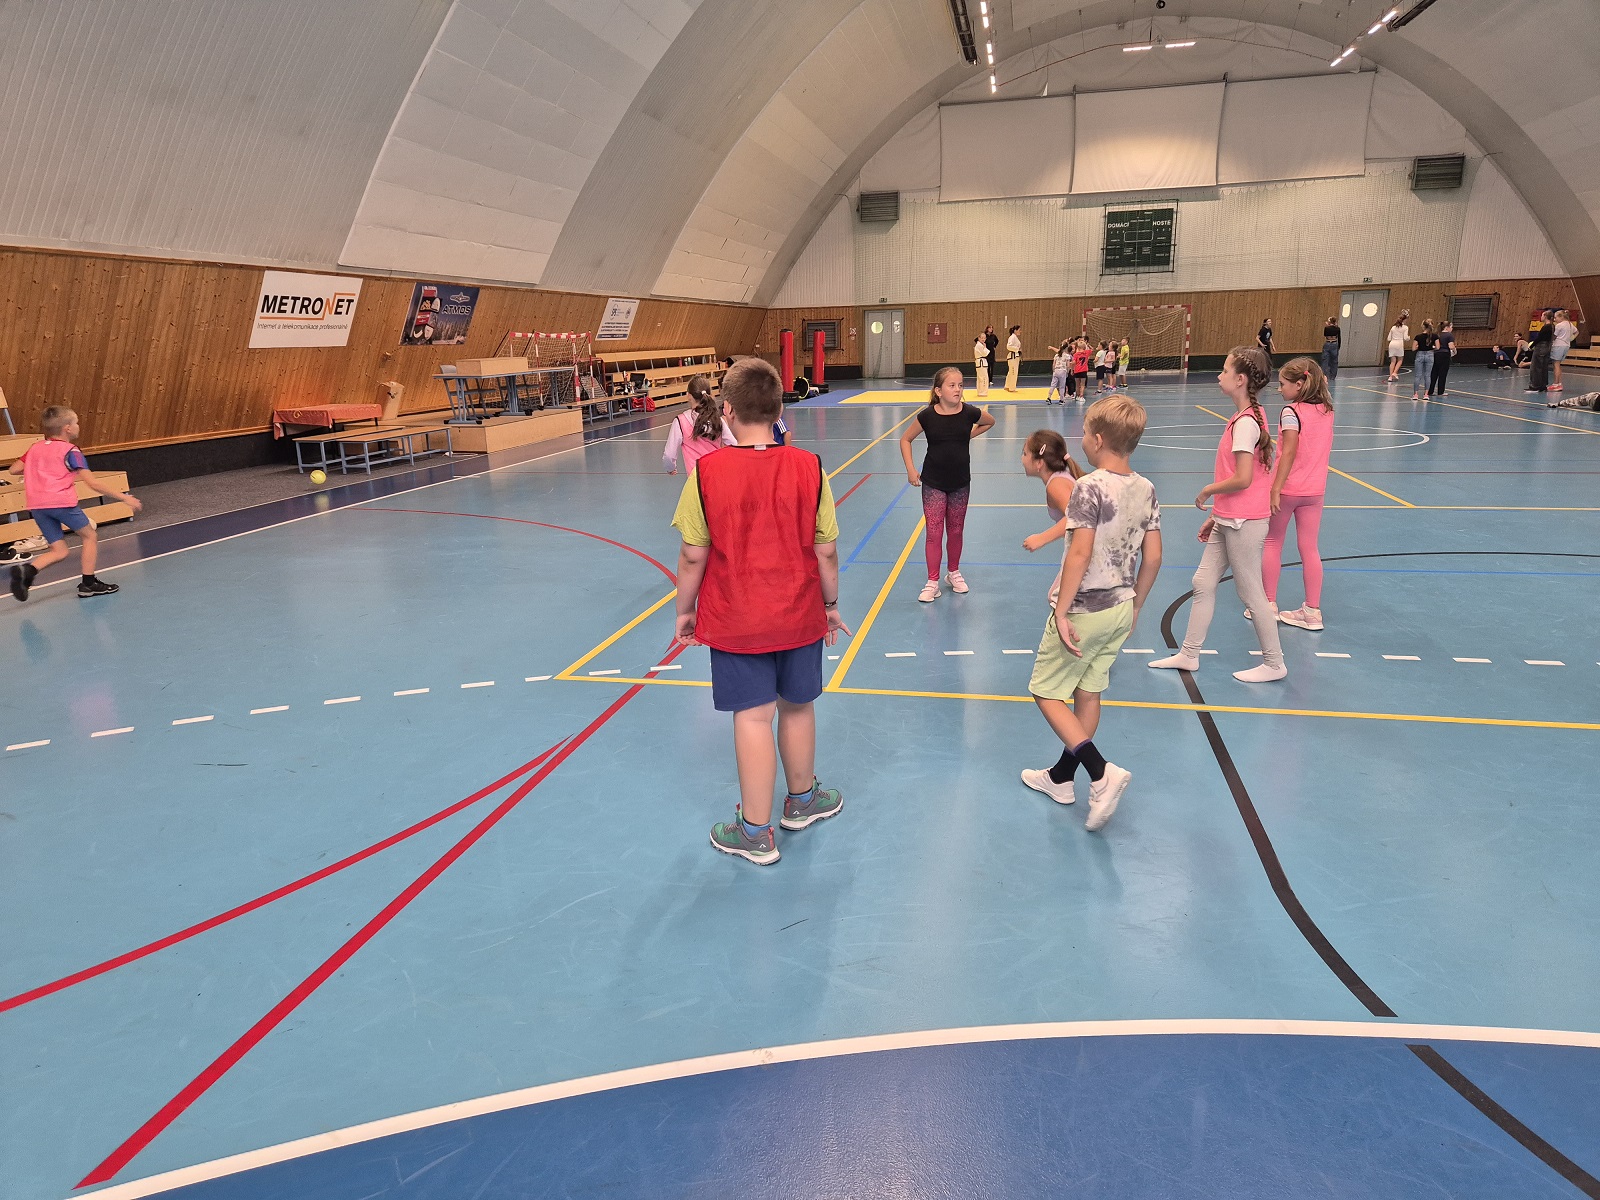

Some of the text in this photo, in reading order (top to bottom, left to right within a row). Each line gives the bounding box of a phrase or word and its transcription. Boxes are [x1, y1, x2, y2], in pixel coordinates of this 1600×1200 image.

[261, 294, 354, 316] METRONET
[442, 304, 472, 315] ATMOS
[1079, 357, 1086, 366] 7
